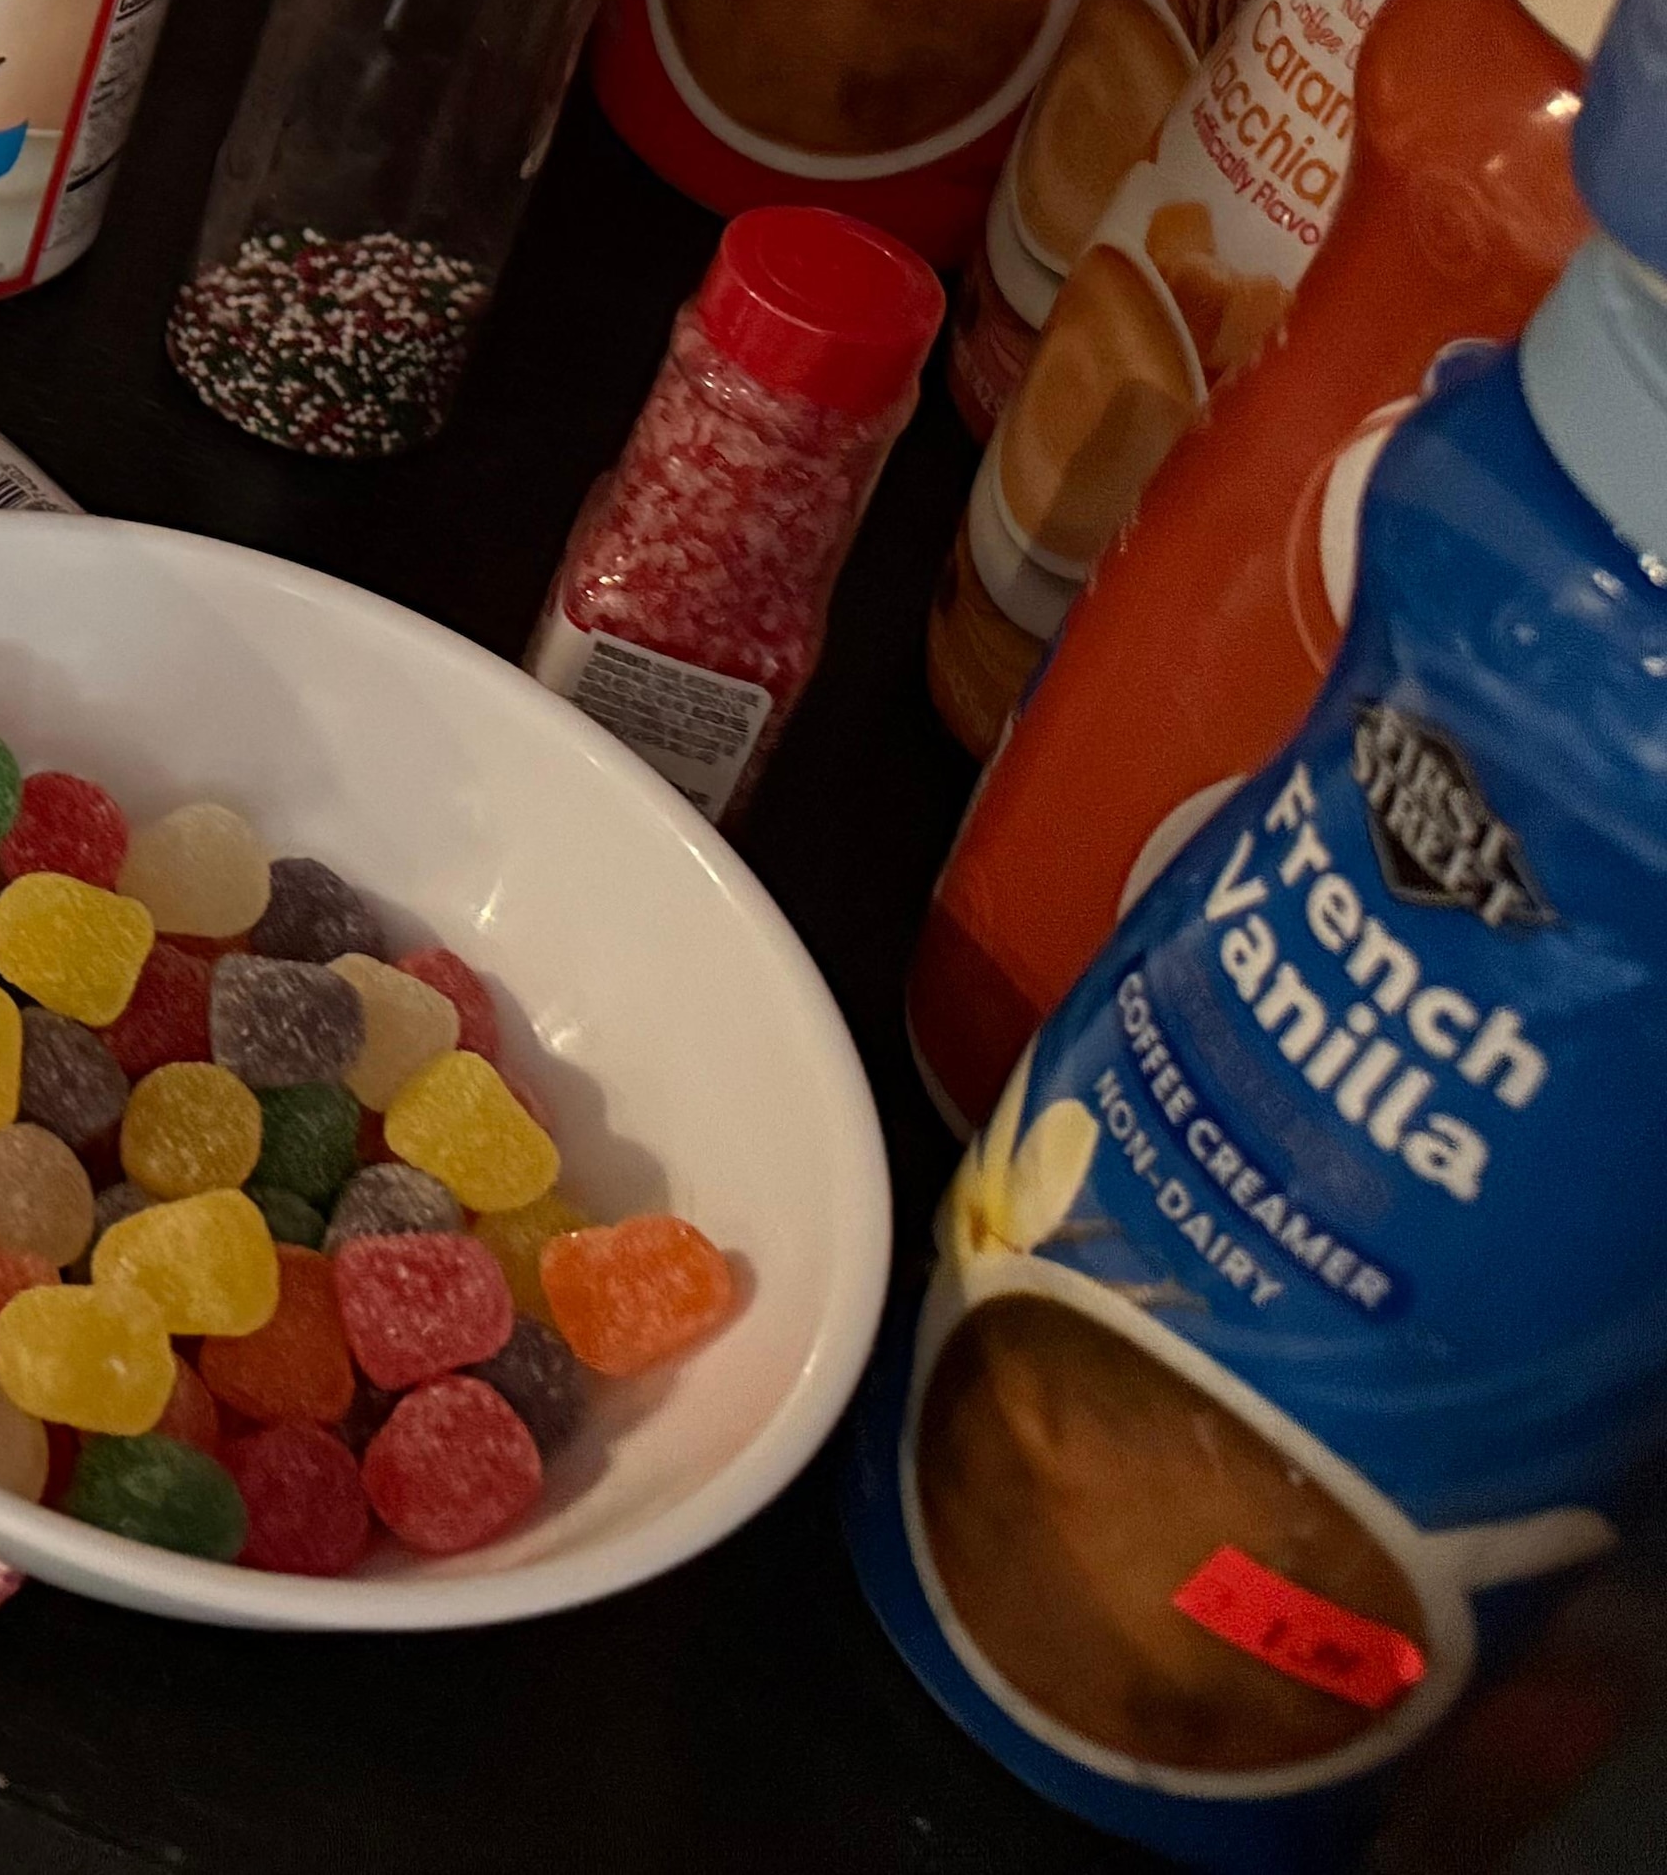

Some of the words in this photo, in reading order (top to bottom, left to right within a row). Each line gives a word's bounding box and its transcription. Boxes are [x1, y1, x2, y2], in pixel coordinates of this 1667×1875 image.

[1210, 55, 1340, 208] acchia
[1251, 181, 1320, 246] Flavo
[1203, 830, 1492, 1204] Vanilla
[1266, 761, 1549, 1111] French
[1092, 1066, 1285, 1311] NON-DAIRY
[1116, 971, 1198, 1125] COFFEE
[1186, 1117, 1393, 1312] CREAMER
